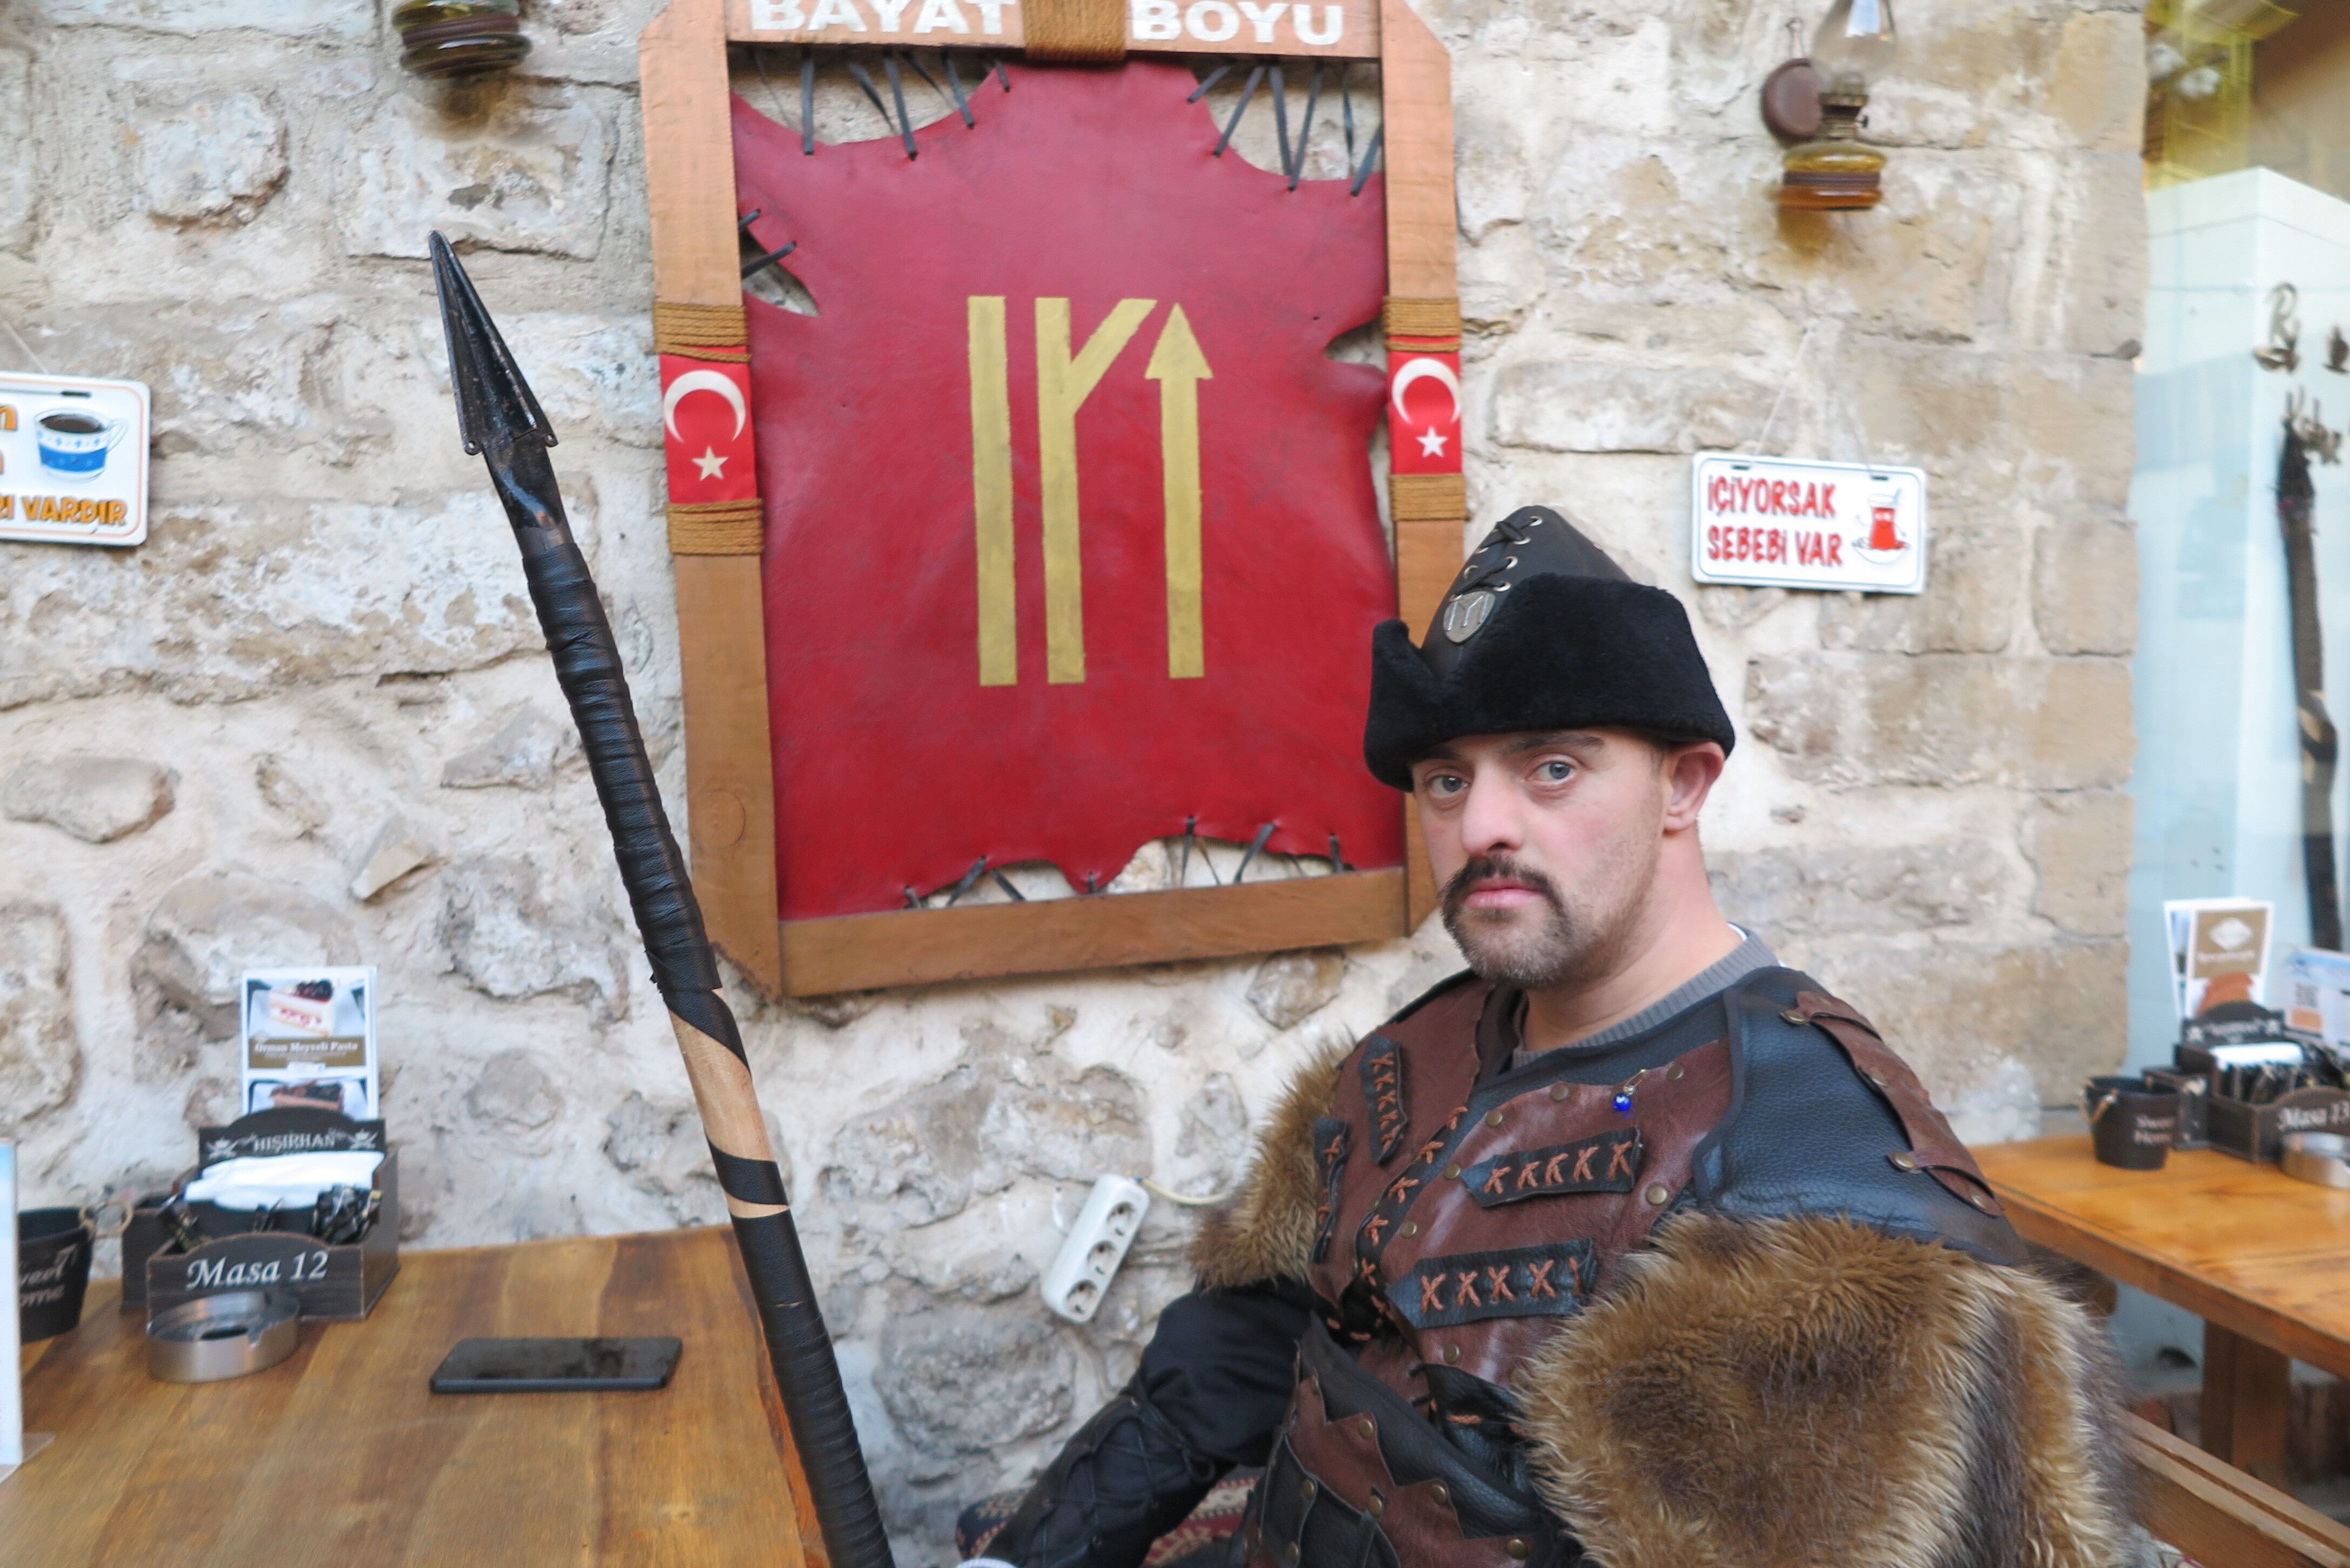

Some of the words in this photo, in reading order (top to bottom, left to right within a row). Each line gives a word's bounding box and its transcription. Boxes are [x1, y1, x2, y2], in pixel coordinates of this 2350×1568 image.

[751, 0, 1021, 35] BAYAT
[1131, 0, 1343, 45] BOYU
[22, 495, 127, 525] VARDIR
[1707, 475, 1837, 518] İÇİYORSAK
[1707, 524, 1788, 565] SEBEBİ
[1794, 530, 1843, 567] VAR
[185, 1256, 281, 1292] Masa
[289, 1249, 329, 1281] 12
